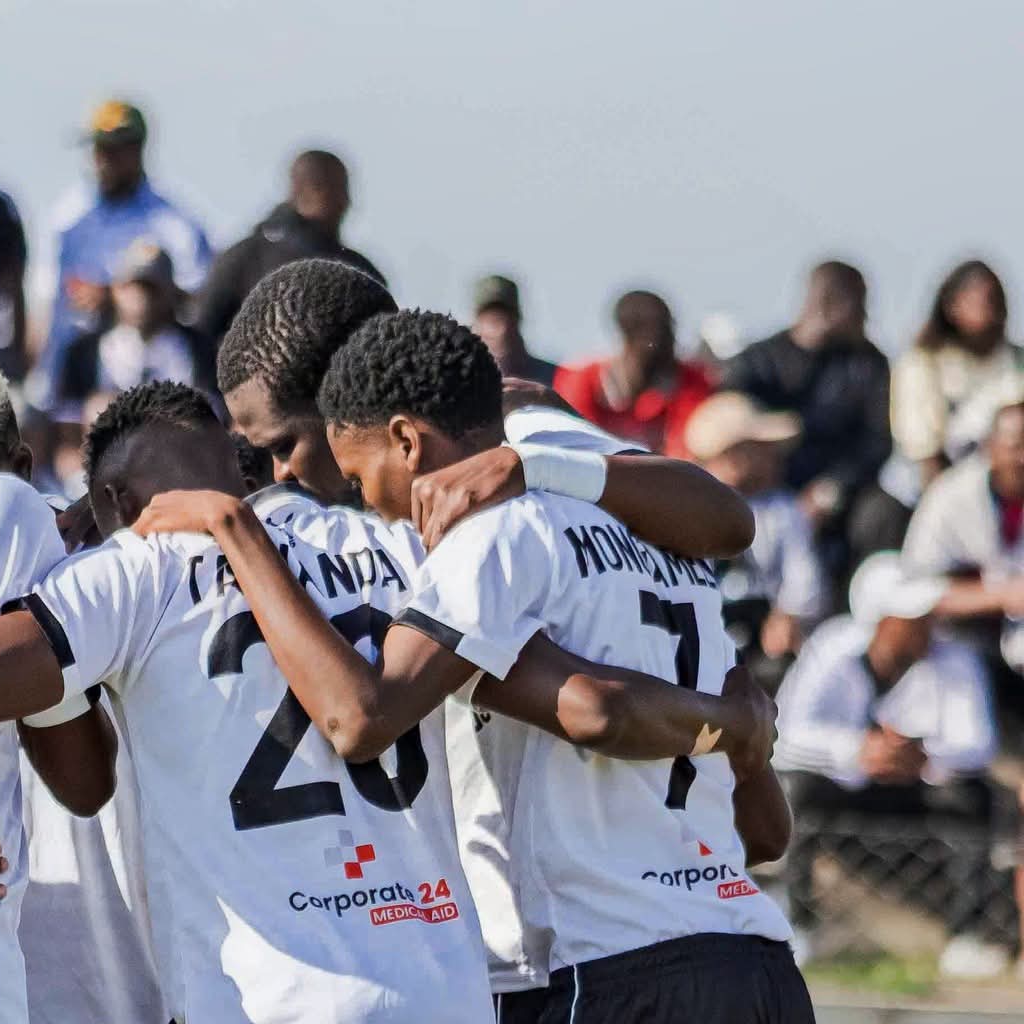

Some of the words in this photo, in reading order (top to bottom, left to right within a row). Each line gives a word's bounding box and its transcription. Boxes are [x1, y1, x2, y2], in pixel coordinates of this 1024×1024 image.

[639, 590, 700, 810] 7
[288, 882, 416, 917] Corporate
[417, 878, 452, 905] 24
[430, 906, 456, 921] AID
